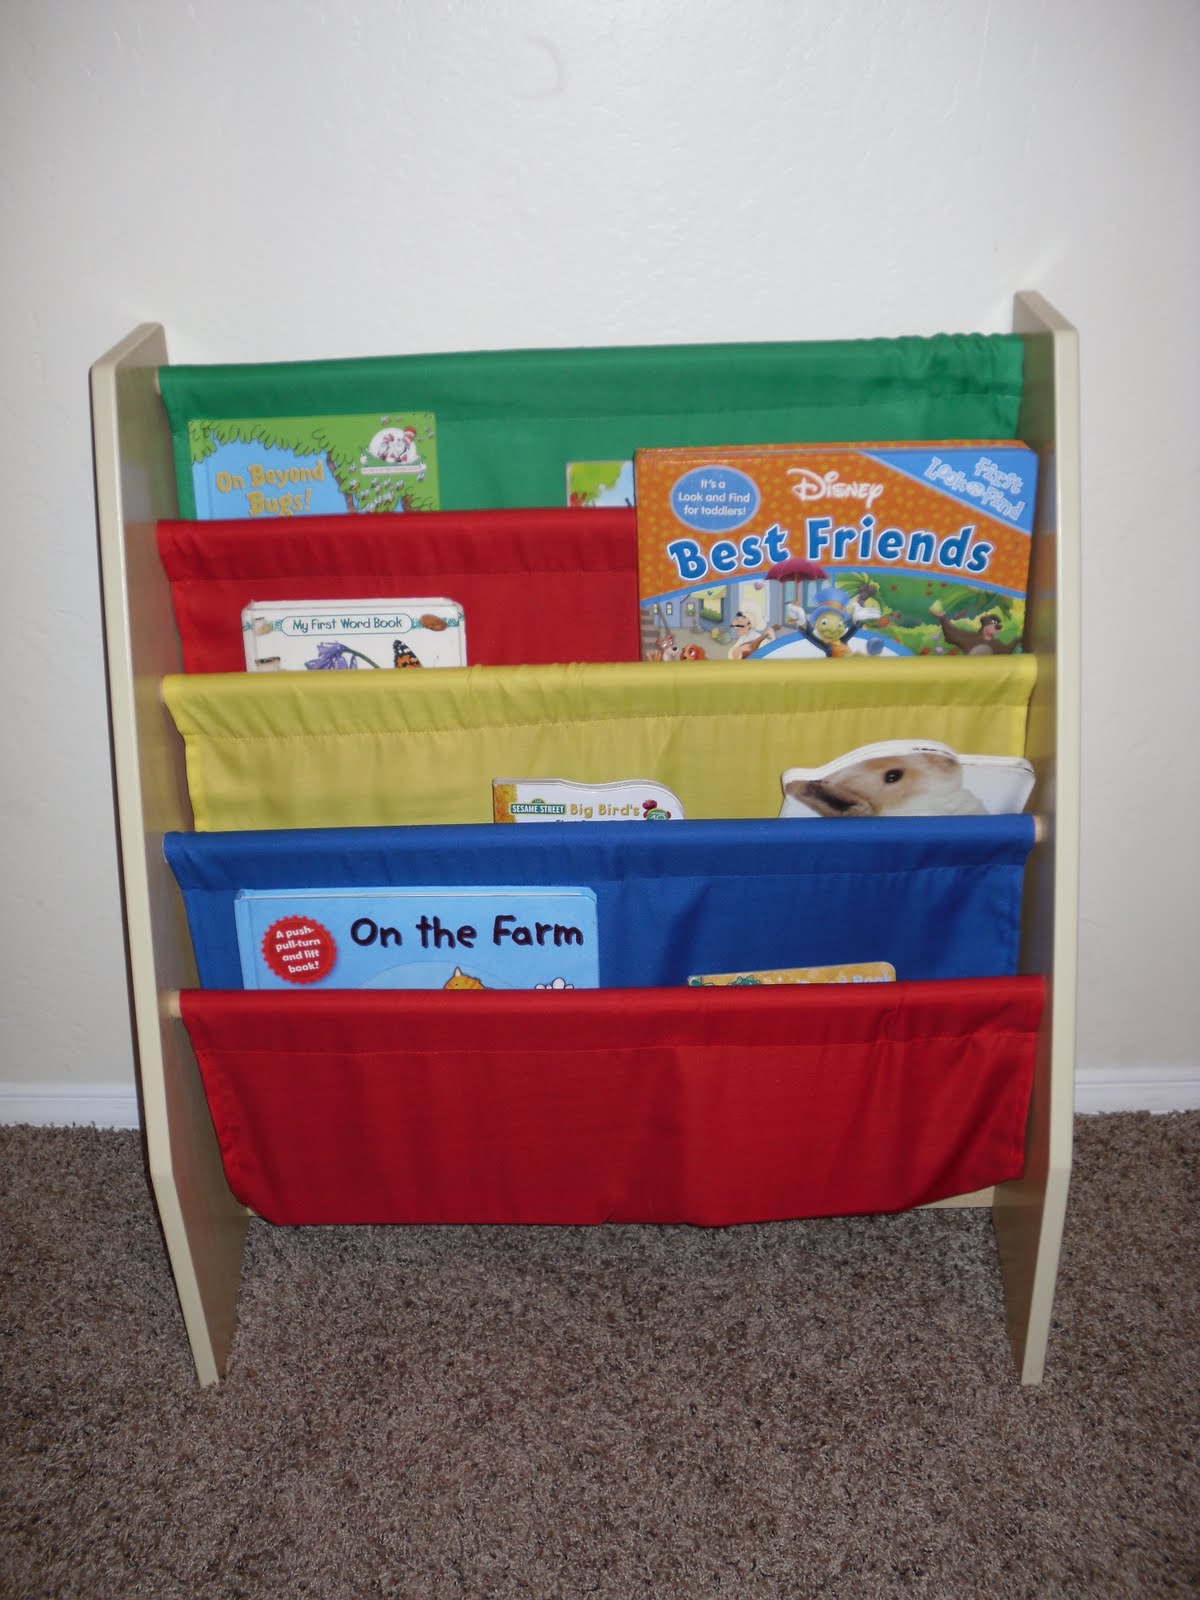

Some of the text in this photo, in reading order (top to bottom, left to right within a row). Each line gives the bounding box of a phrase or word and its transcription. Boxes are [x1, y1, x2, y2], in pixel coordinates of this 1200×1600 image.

[216, 459, 325, 493] On Beyond
[974, 456, 1024, 495] First
[700, 479, 726, 489] It's a
[923, 456, 968, 493] Look
[980, 485, 1026, 521] Find
[246, 488, 312, 517] Bugs!
[678, 491, 751, 503] Look and Find
[683, 504, 746, 516] for toddlers!
[667, 513, 995, 582] Best Friends
[292, 616, 403, 633] My First Word Book
[512, 804, 565, 814] SESAME STREET
[570, 803, 640, 818] Big Bird's
[275, 925, 315, 940] A push-
[350, 914, 584, 949] On the Farm
[275, 938, 321, 953] pull-turn
[282, 948, 320, 962] and lift
[288, 960, 320, 974] book!
